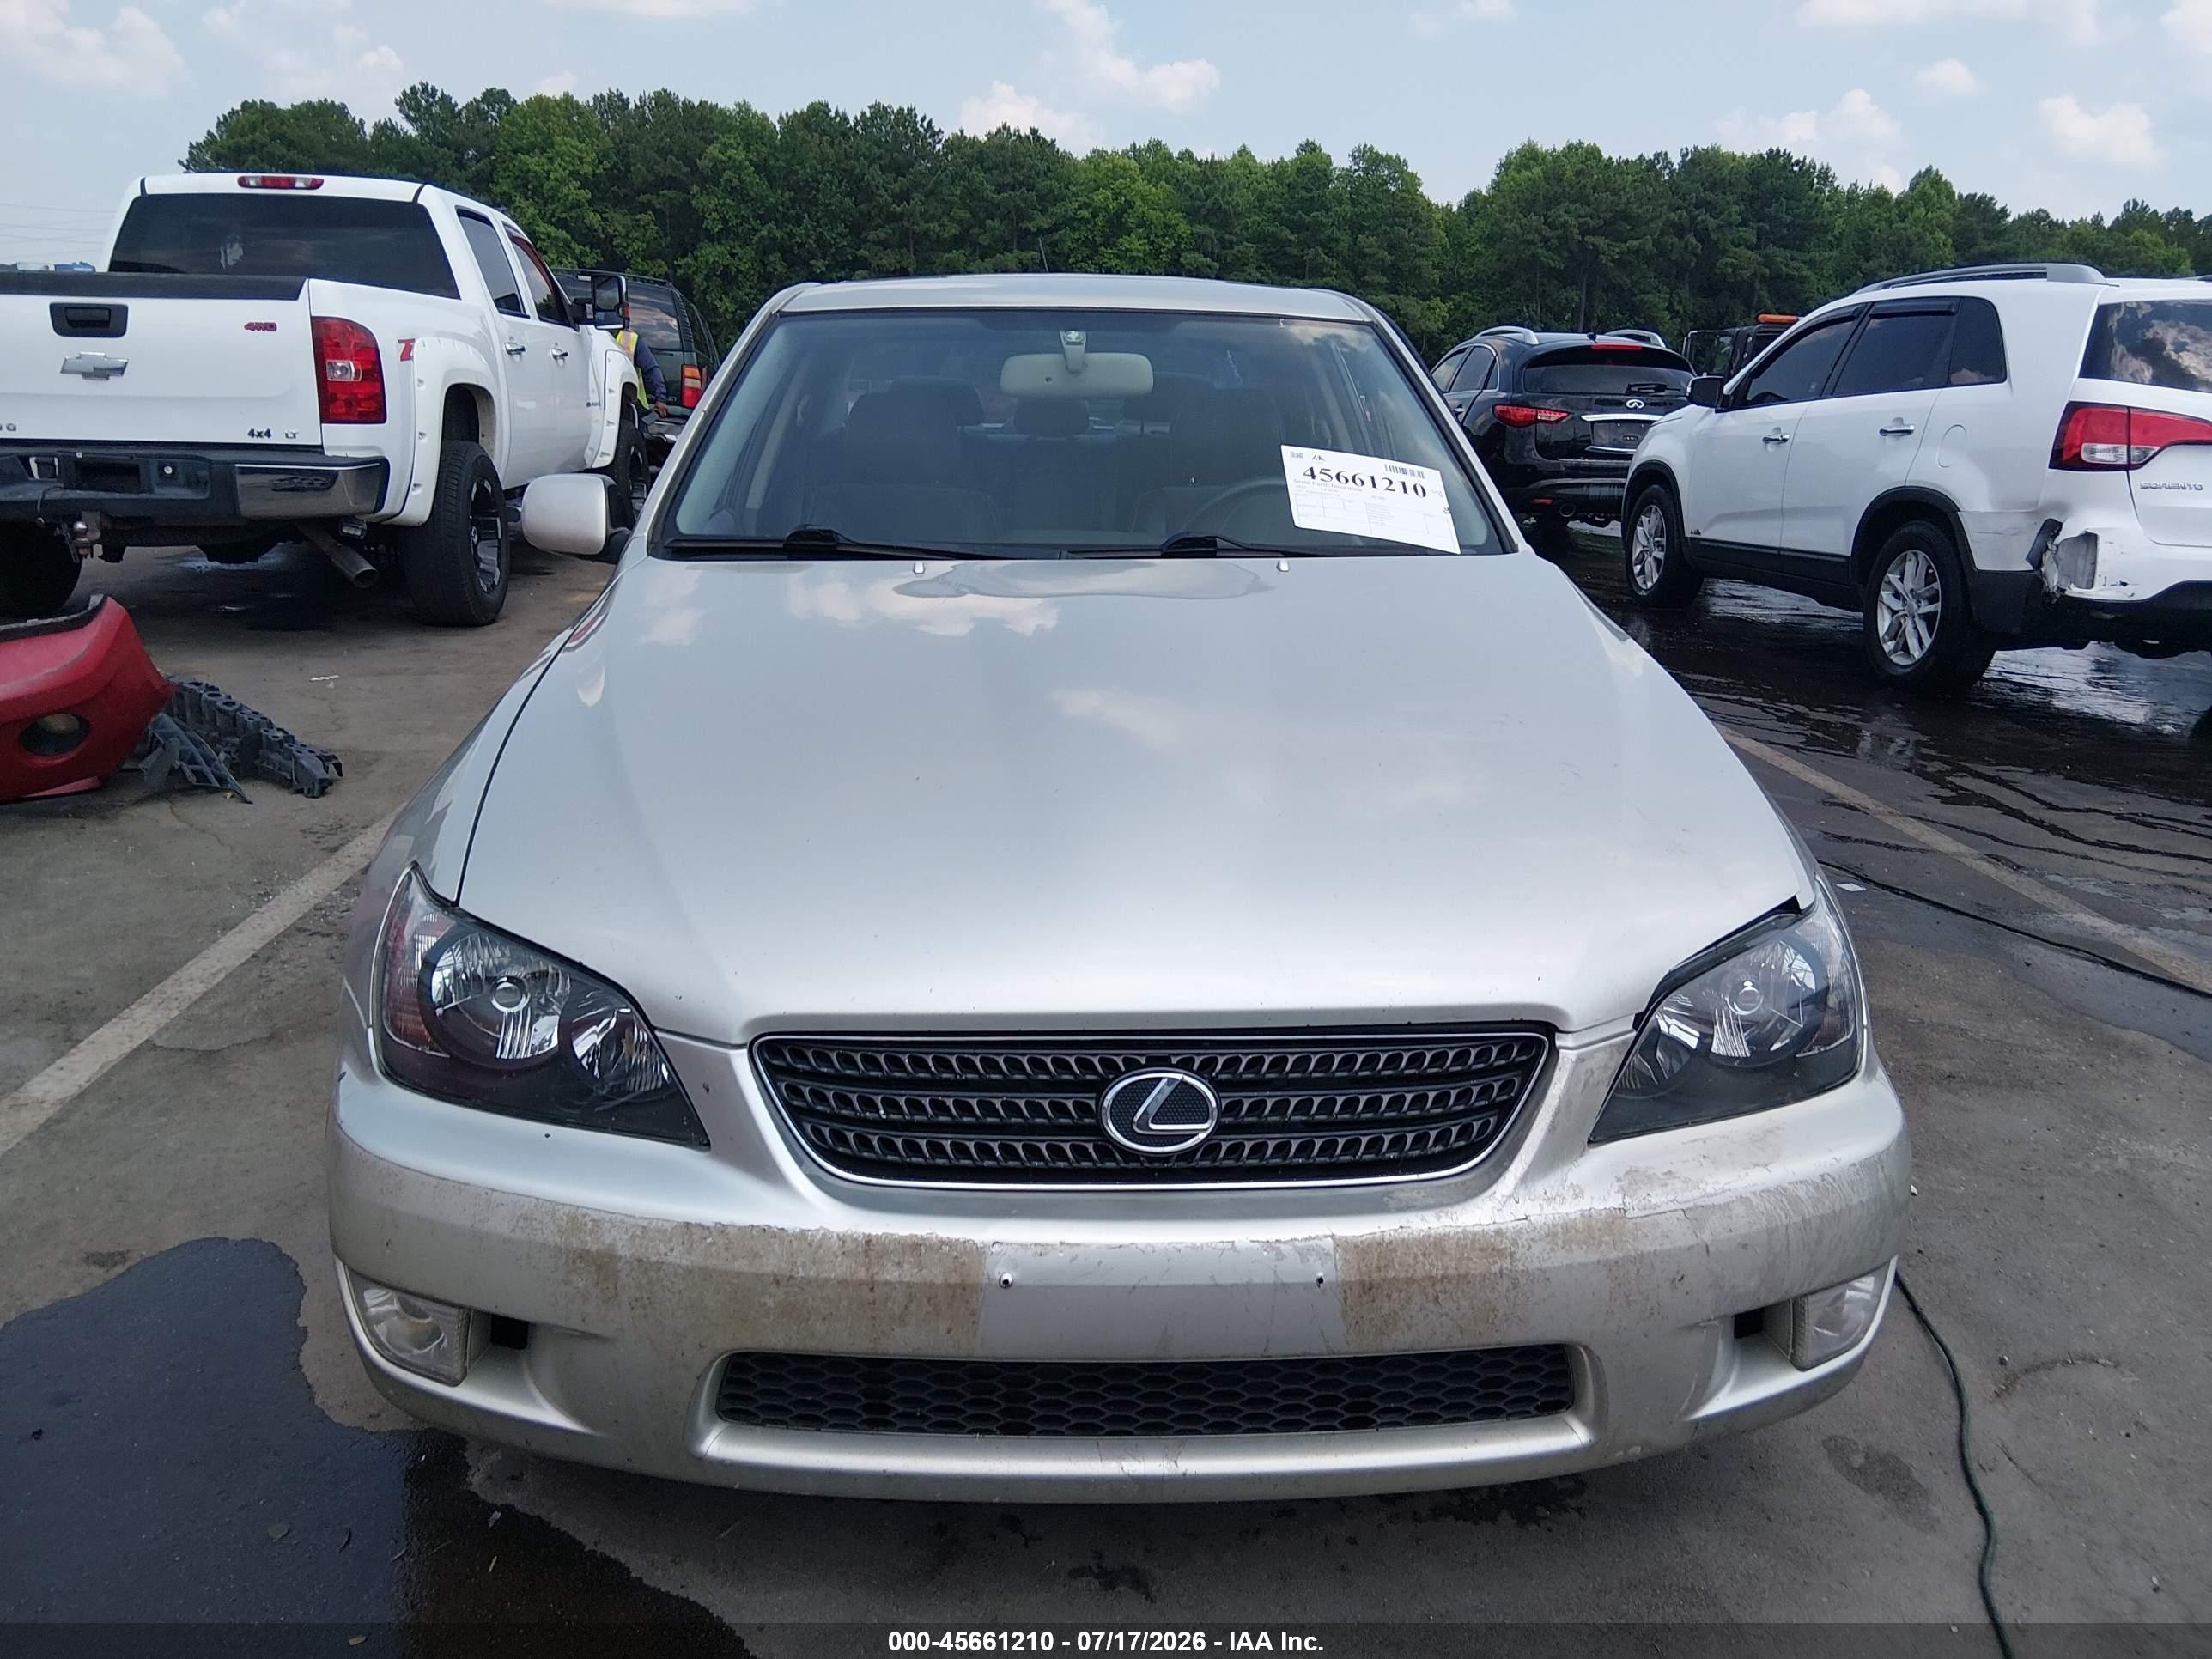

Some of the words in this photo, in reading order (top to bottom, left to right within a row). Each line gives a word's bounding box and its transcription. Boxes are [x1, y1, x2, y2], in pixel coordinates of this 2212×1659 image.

[247, 428, 272, 439] 4x4
[1303, 466, 1427, 498] 45661210
[2139, 481, 2204, 491] SORENTO
